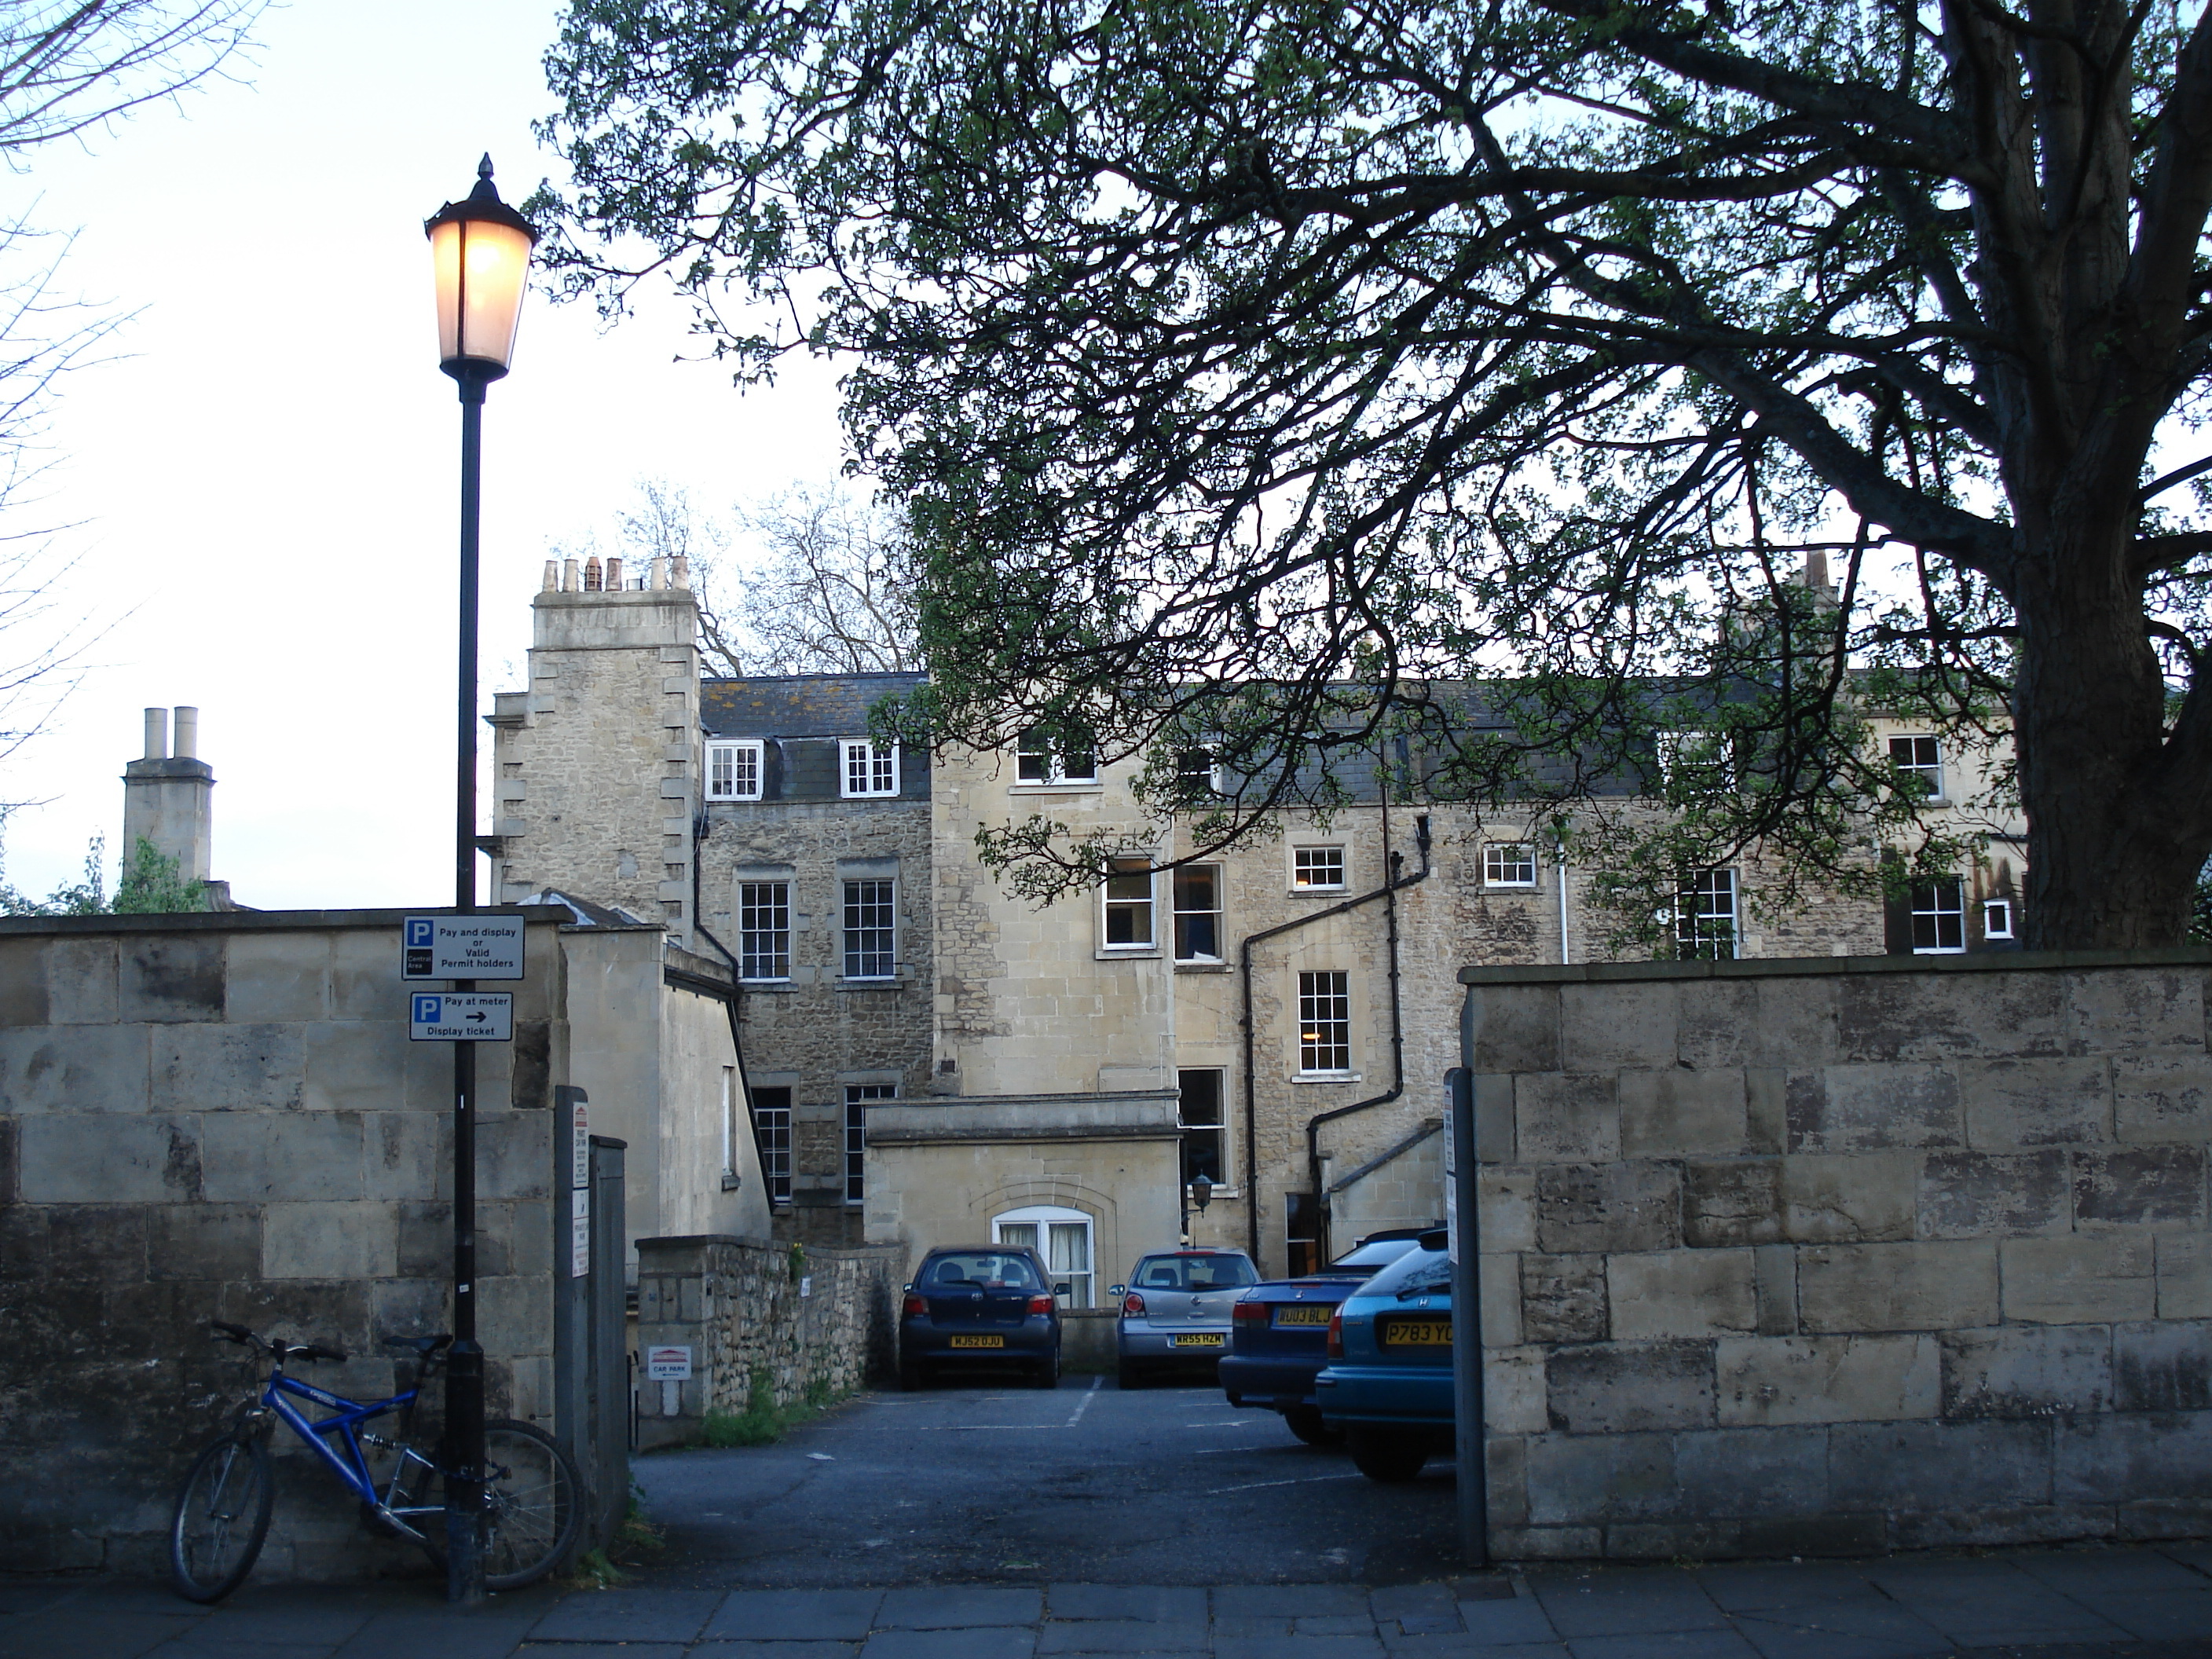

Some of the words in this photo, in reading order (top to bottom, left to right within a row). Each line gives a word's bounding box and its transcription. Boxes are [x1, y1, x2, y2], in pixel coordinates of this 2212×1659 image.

[413, 922, 430, 944] P
[440, 928, 457, 937] Pay
[460, 928, 478, 936] and
[482, 928, 516, 937] display
[441, 959, 474, 968] Permit
[477, 959, 514, 968] holders
[445, 997, 463, 1006] Pay
[420, 999, 438, 1021] P
[427, 1027, 463, 1036] Display
[467, 1027, 495, 1035] ticket
[1388, 1325, 1431, 1342] P783
